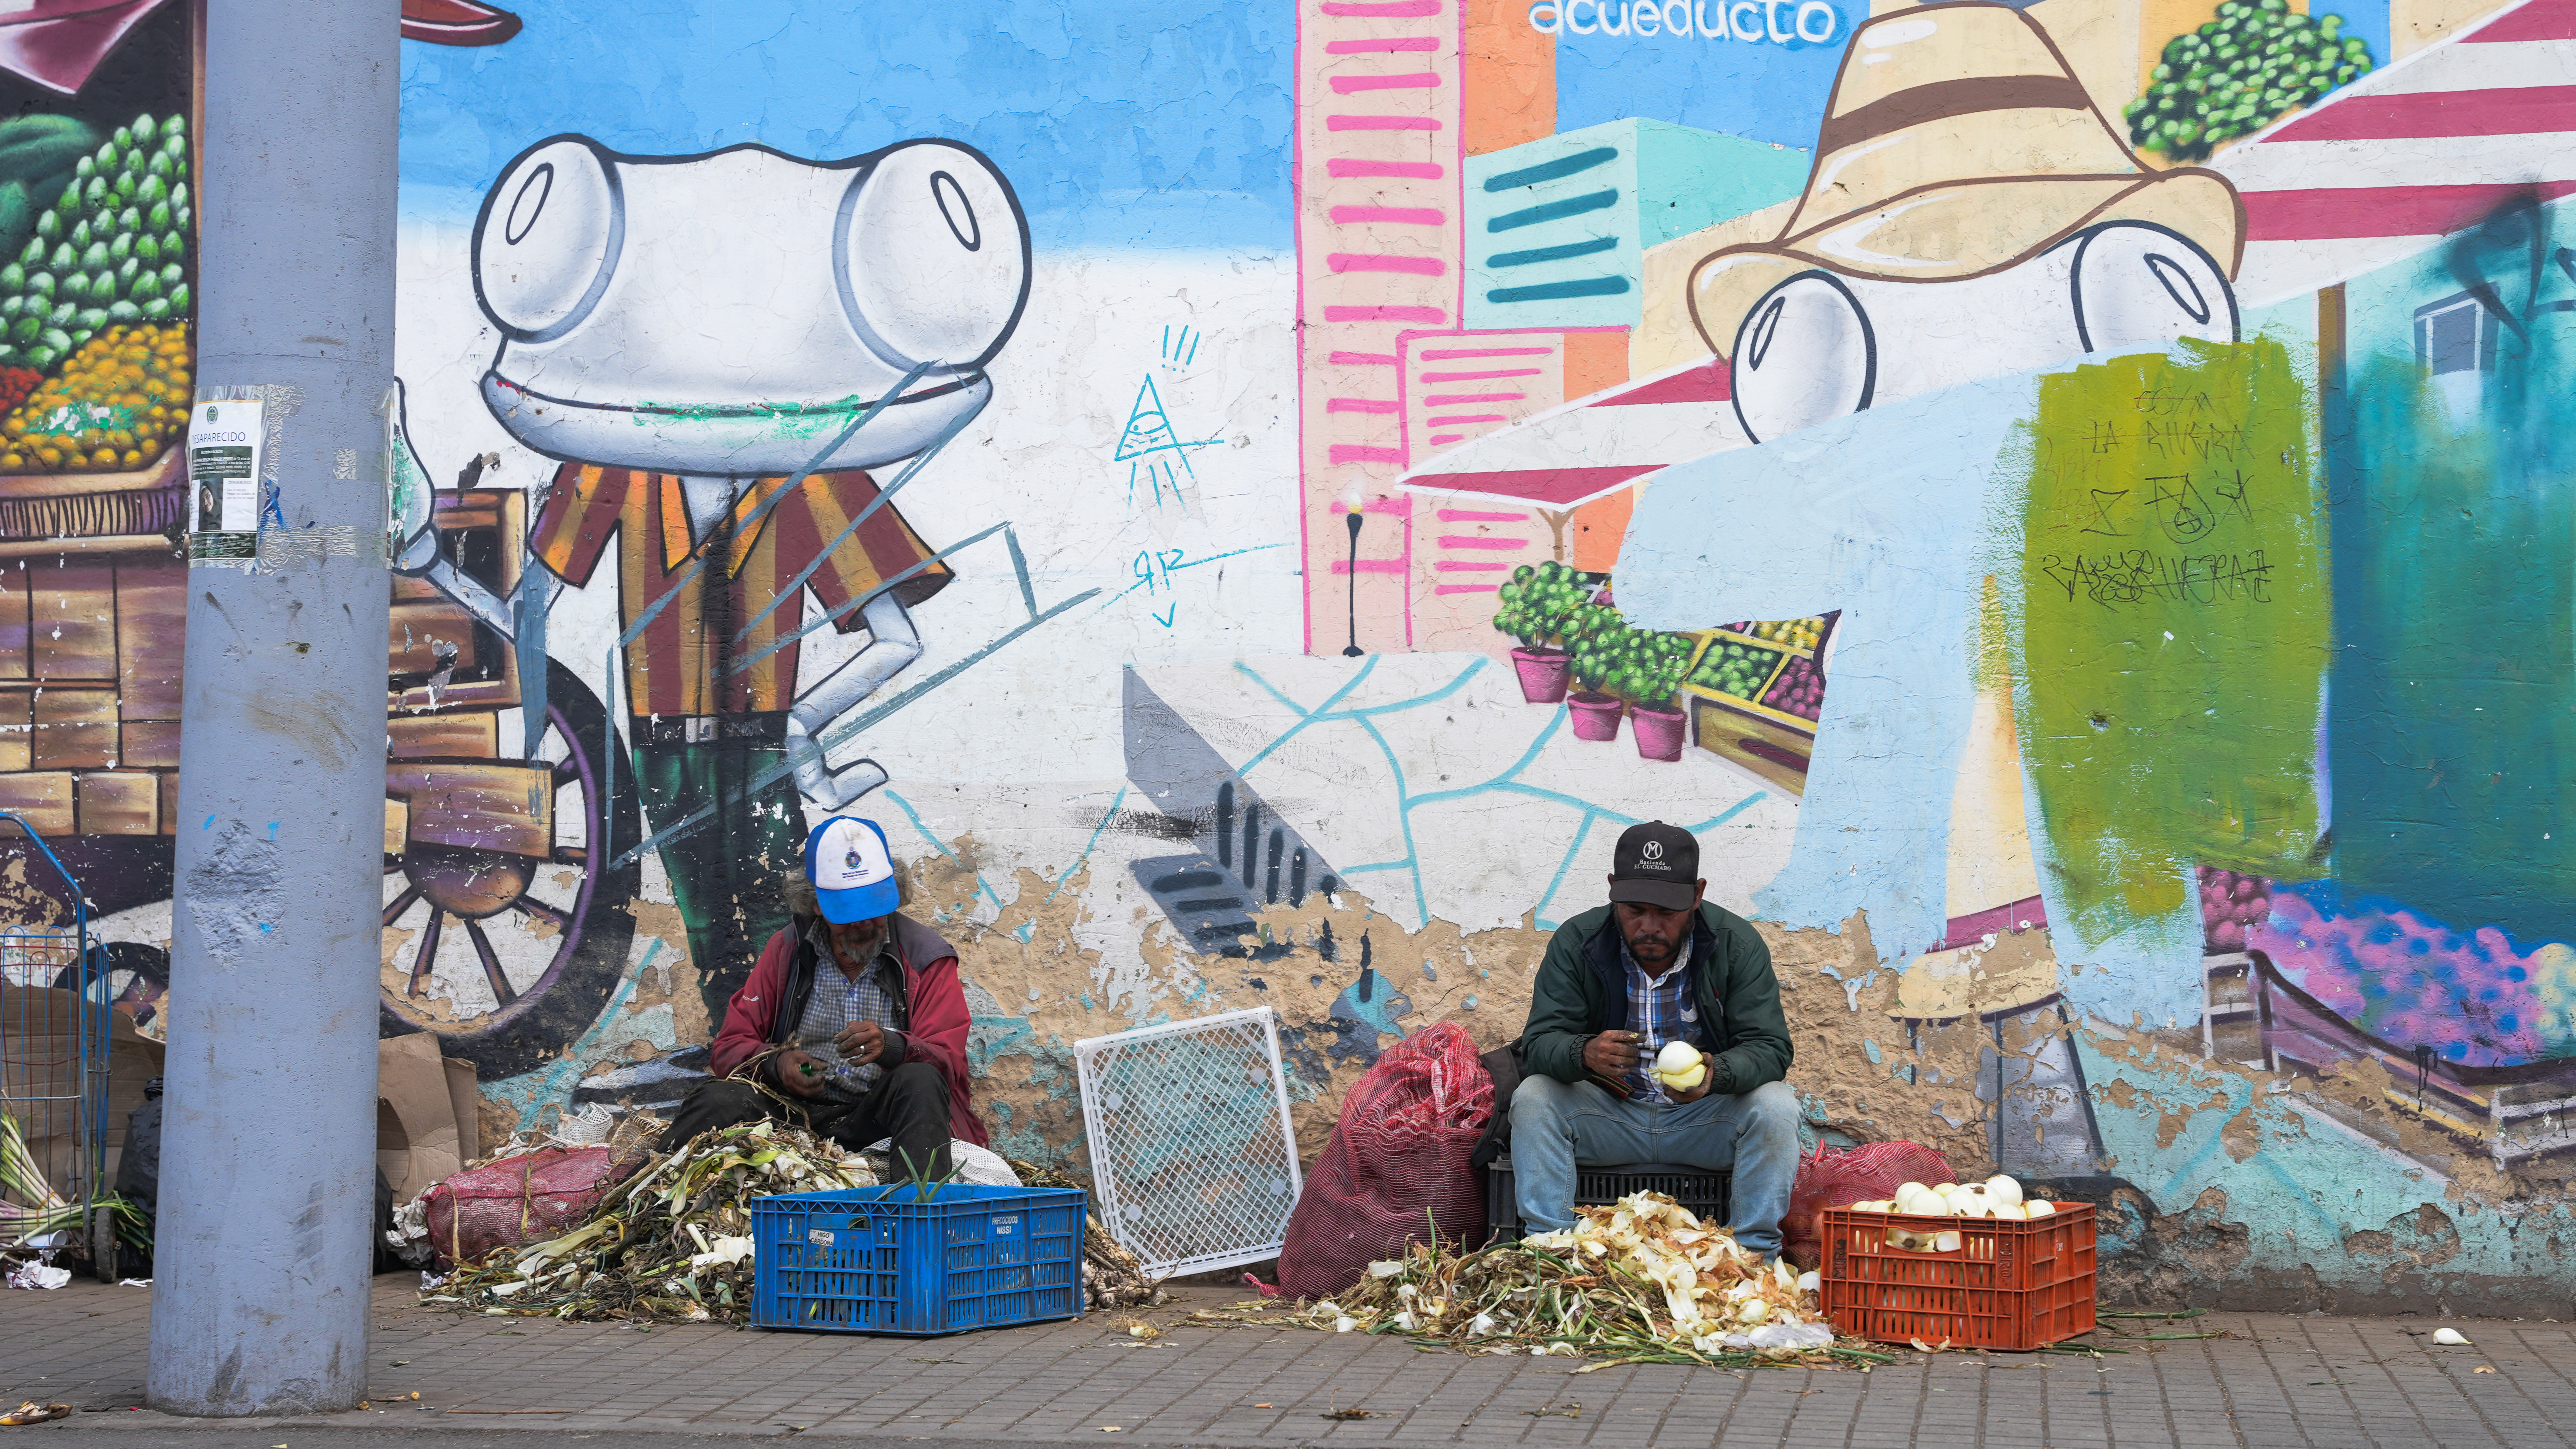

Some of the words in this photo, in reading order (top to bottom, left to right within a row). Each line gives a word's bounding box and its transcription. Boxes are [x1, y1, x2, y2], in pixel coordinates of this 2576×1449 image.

[1528, 0, 1836, 43] acueducto
[996, 1225, 1011, 1234] NISSI
[810, 1237, 833, 1246] CARDONA
